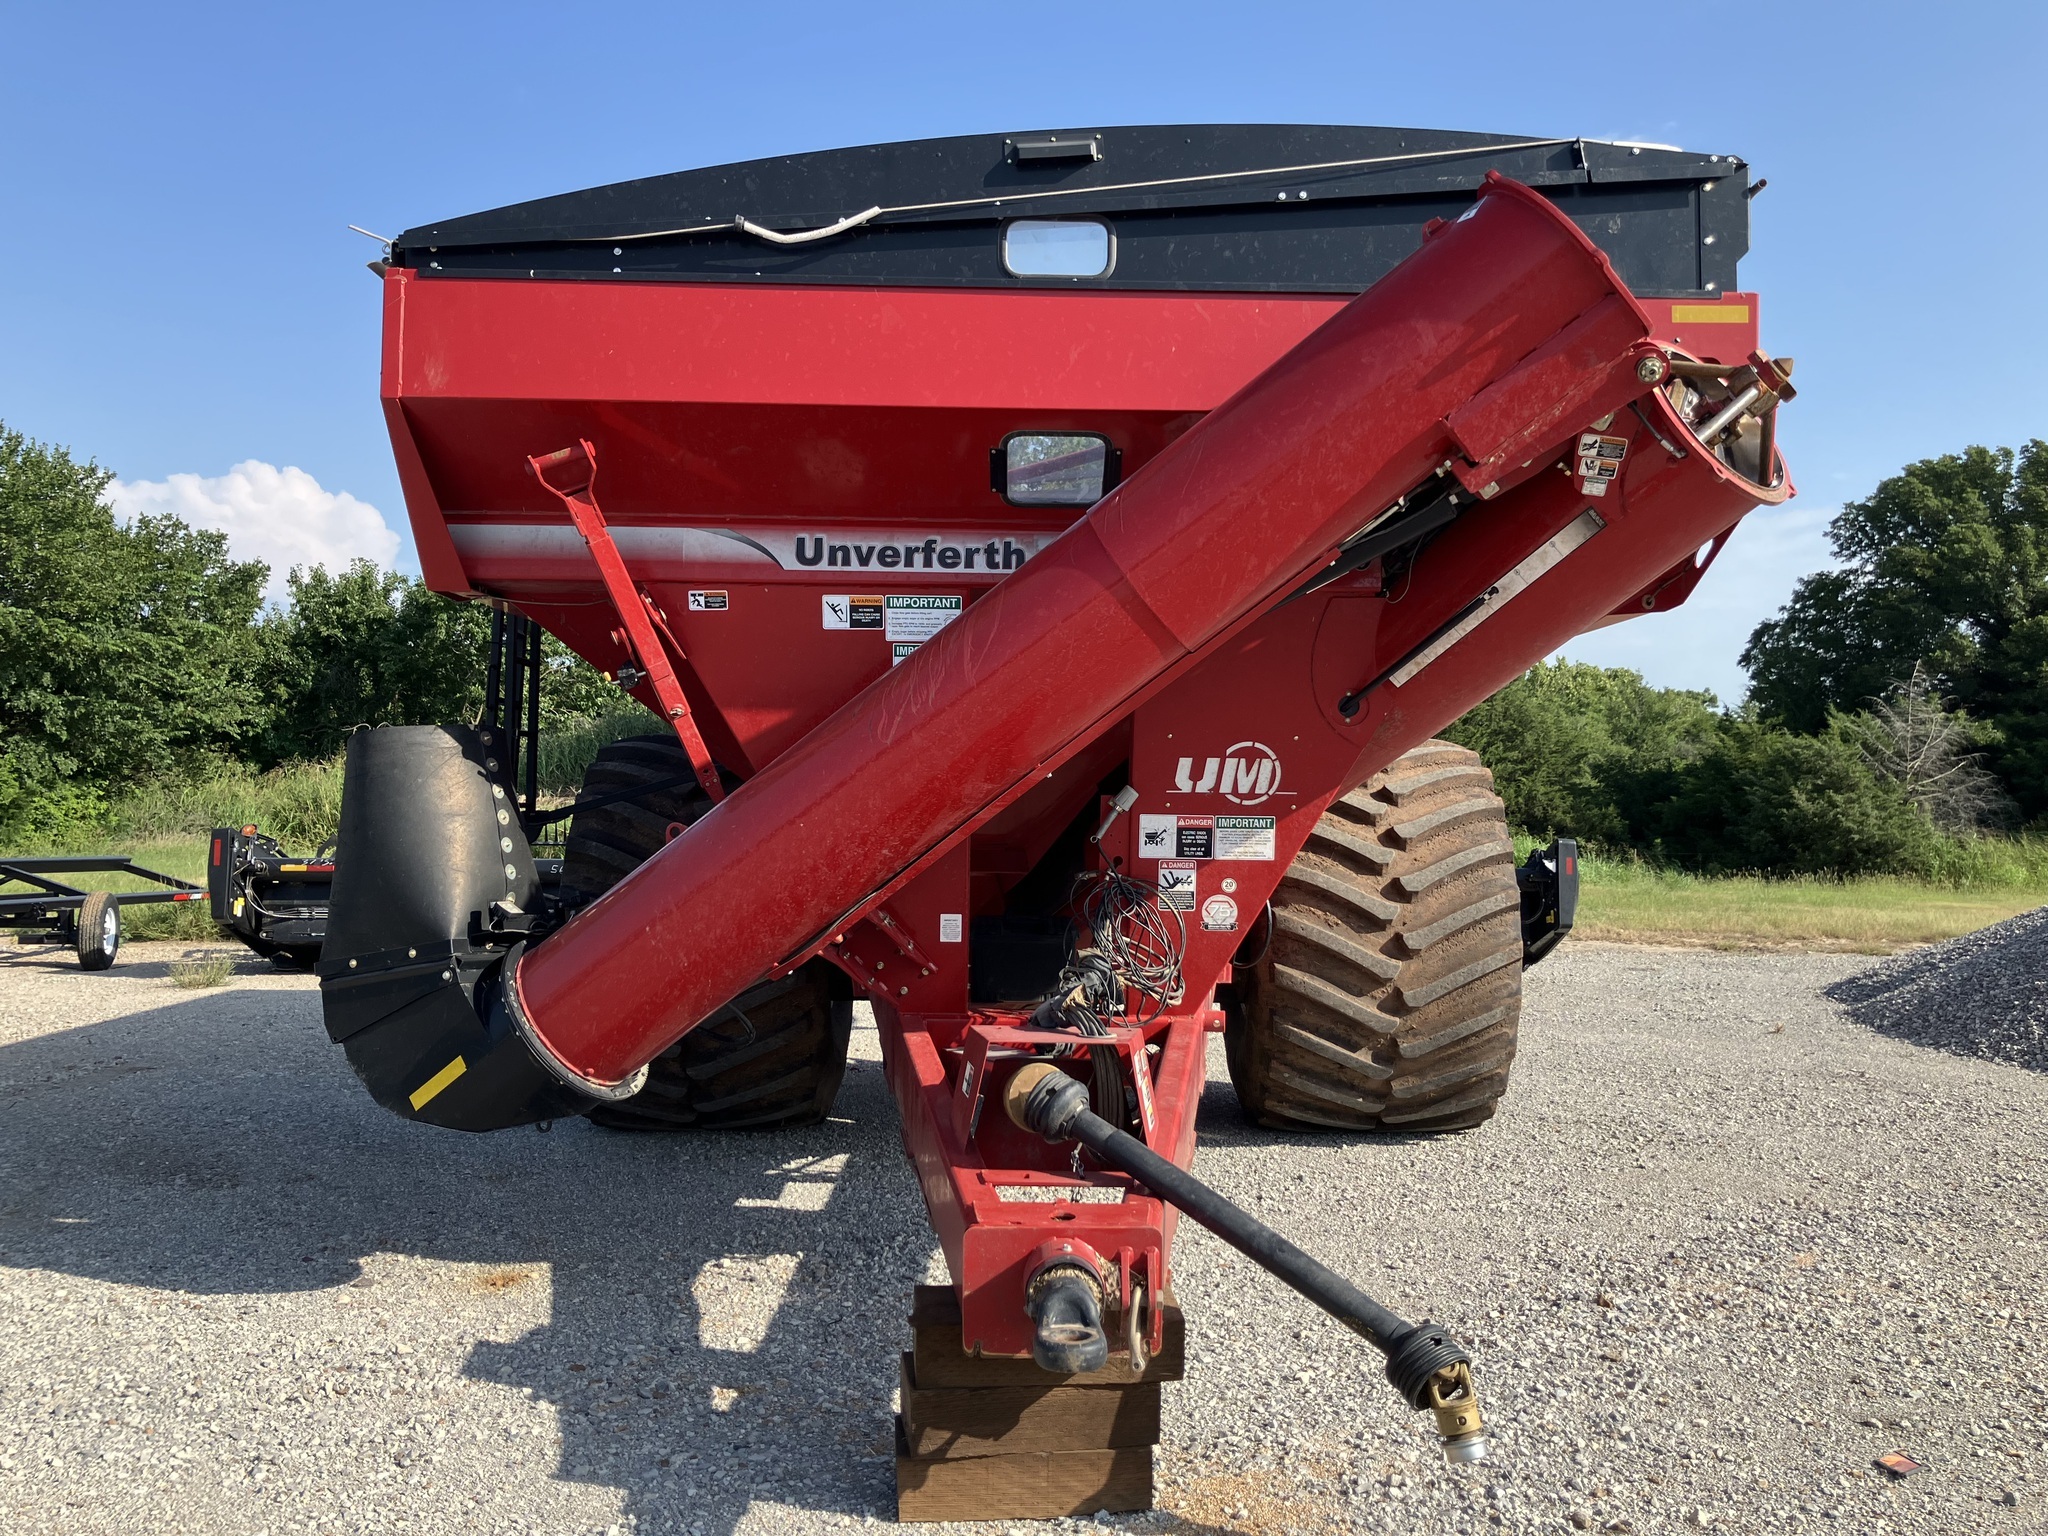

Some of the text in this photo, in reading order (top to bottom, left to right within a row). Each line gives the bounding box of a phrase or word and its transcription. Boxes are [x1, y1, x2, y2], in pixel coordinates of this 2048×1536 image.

[795, 536, 1026, 570] Unverferth
[889, 597, 958, 608] IMPORTANT
[896, 646, 919, 656] IMP
[1218, 818, 1272, 828] IMPORTANT
[1209, 905, 1231, 917] 75
